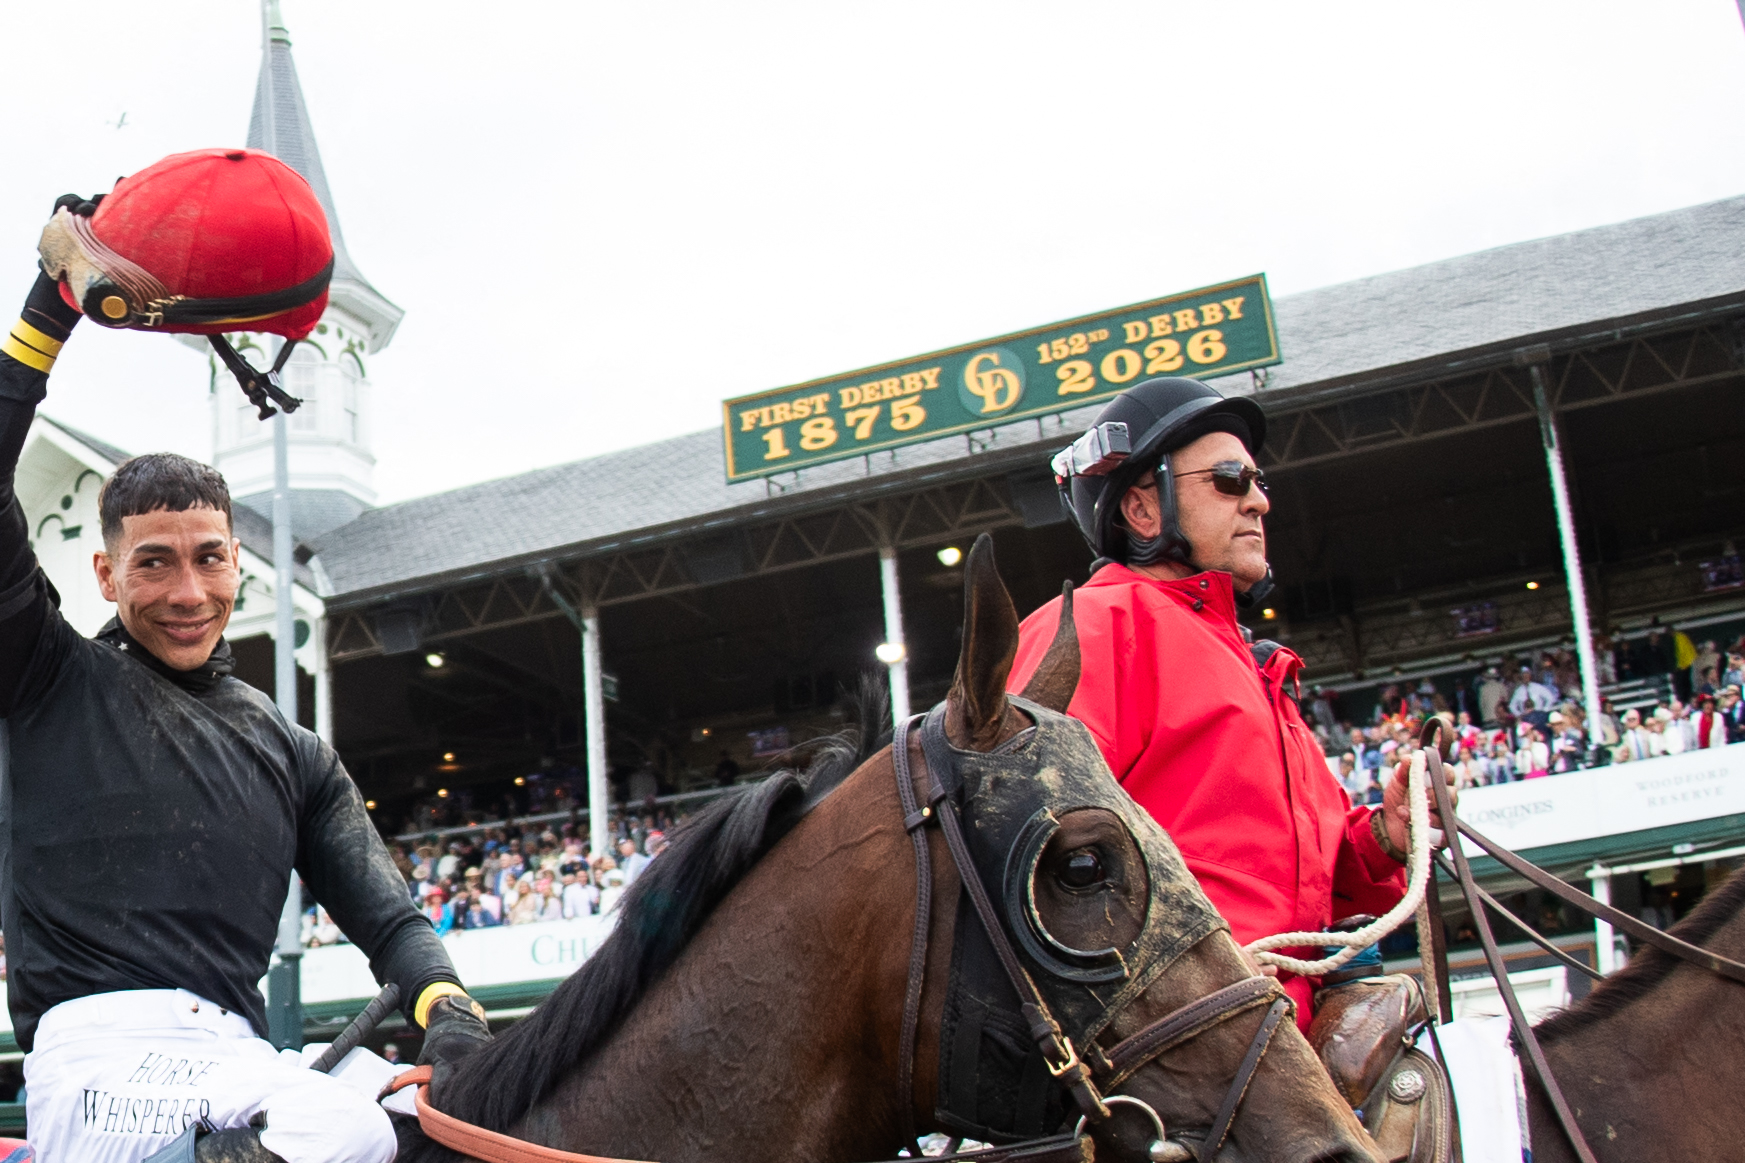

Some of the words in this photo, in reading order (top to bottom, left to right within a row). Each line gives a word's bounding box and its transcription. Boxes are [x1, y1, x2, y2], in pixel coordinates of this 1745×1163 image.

[1123, 294, 1247, 345] DERBY
[1055, 328, 1228, 397] 2026
[739, 393, 831, 434] FIRST
[838, 366, 943, 411] DERBY
[762, 394, 928, 461] 1875
[1635, 767, 1730, 792] WOODFORD
[1647, 785, 1725, 808] RESERVE
[1466, 799, 1554, 825] LONGINES
[126, 1052, 219, 1087] HORSE
[82, 1088, 219, 1136] WHISPERER
